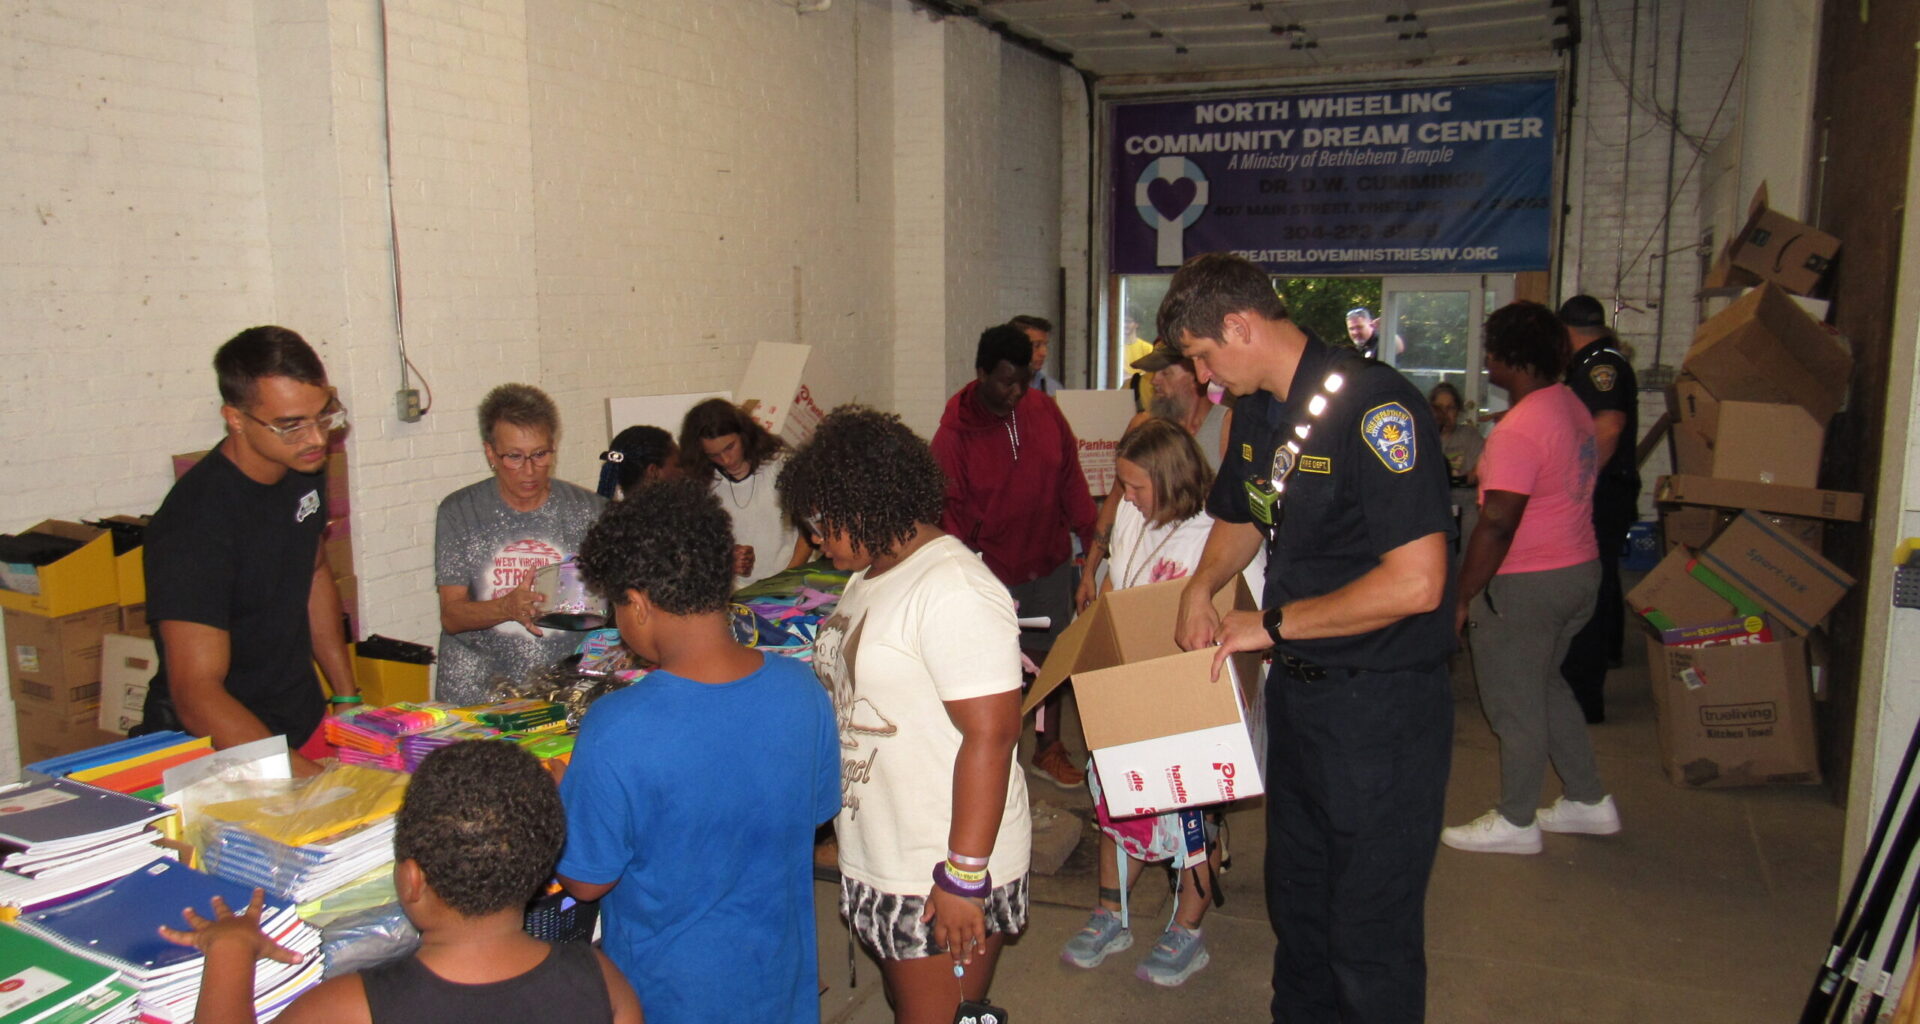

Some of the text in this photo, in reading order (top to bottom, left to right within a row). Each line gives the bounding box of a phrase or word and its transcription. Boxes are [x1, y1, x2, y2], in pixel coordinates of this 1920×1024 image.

[1195, 91, 1452, 124] NORTH WHEELING
[1125, 117, 1543, 154] COMMUNITY DREAM CENTER
[1227, 145, 1454, 172] A Ministry of Bethlehem Temple
[495, 557, 550, 567] WEST VIRGINIA
[1171, 765, 1187, 804] handle
